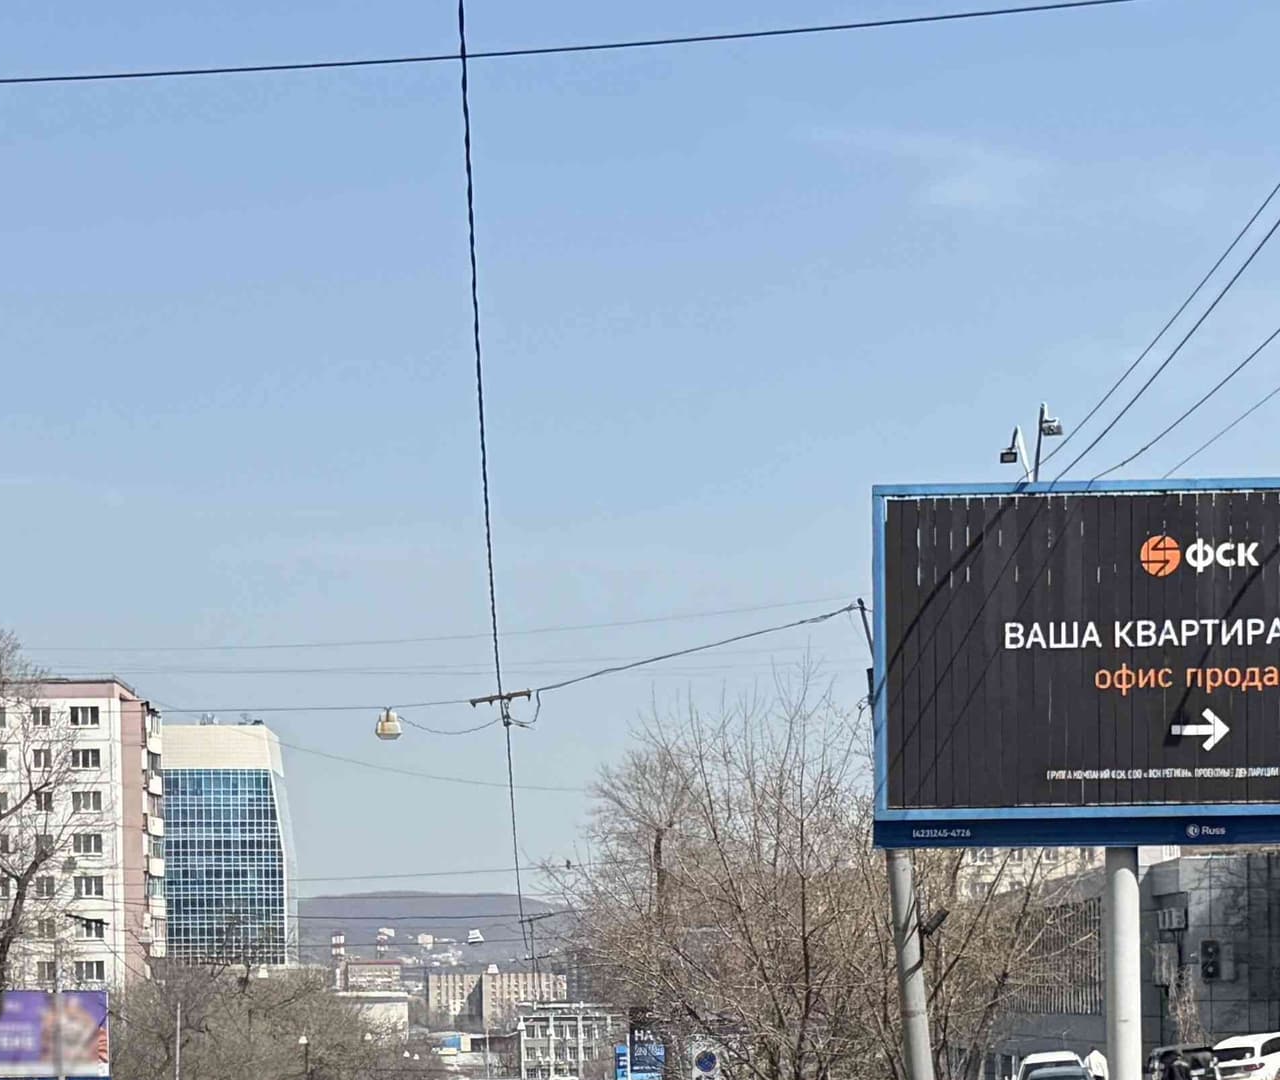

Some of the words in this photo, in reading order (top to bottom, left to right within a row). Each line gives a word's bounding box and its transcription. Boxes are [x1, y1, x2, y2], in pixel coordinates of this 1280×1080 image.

[1004, 619, 1103, 650] ВАША
[1095, 664, 1173, 696] офис
[1201, 825, 1226, 835] Russ
